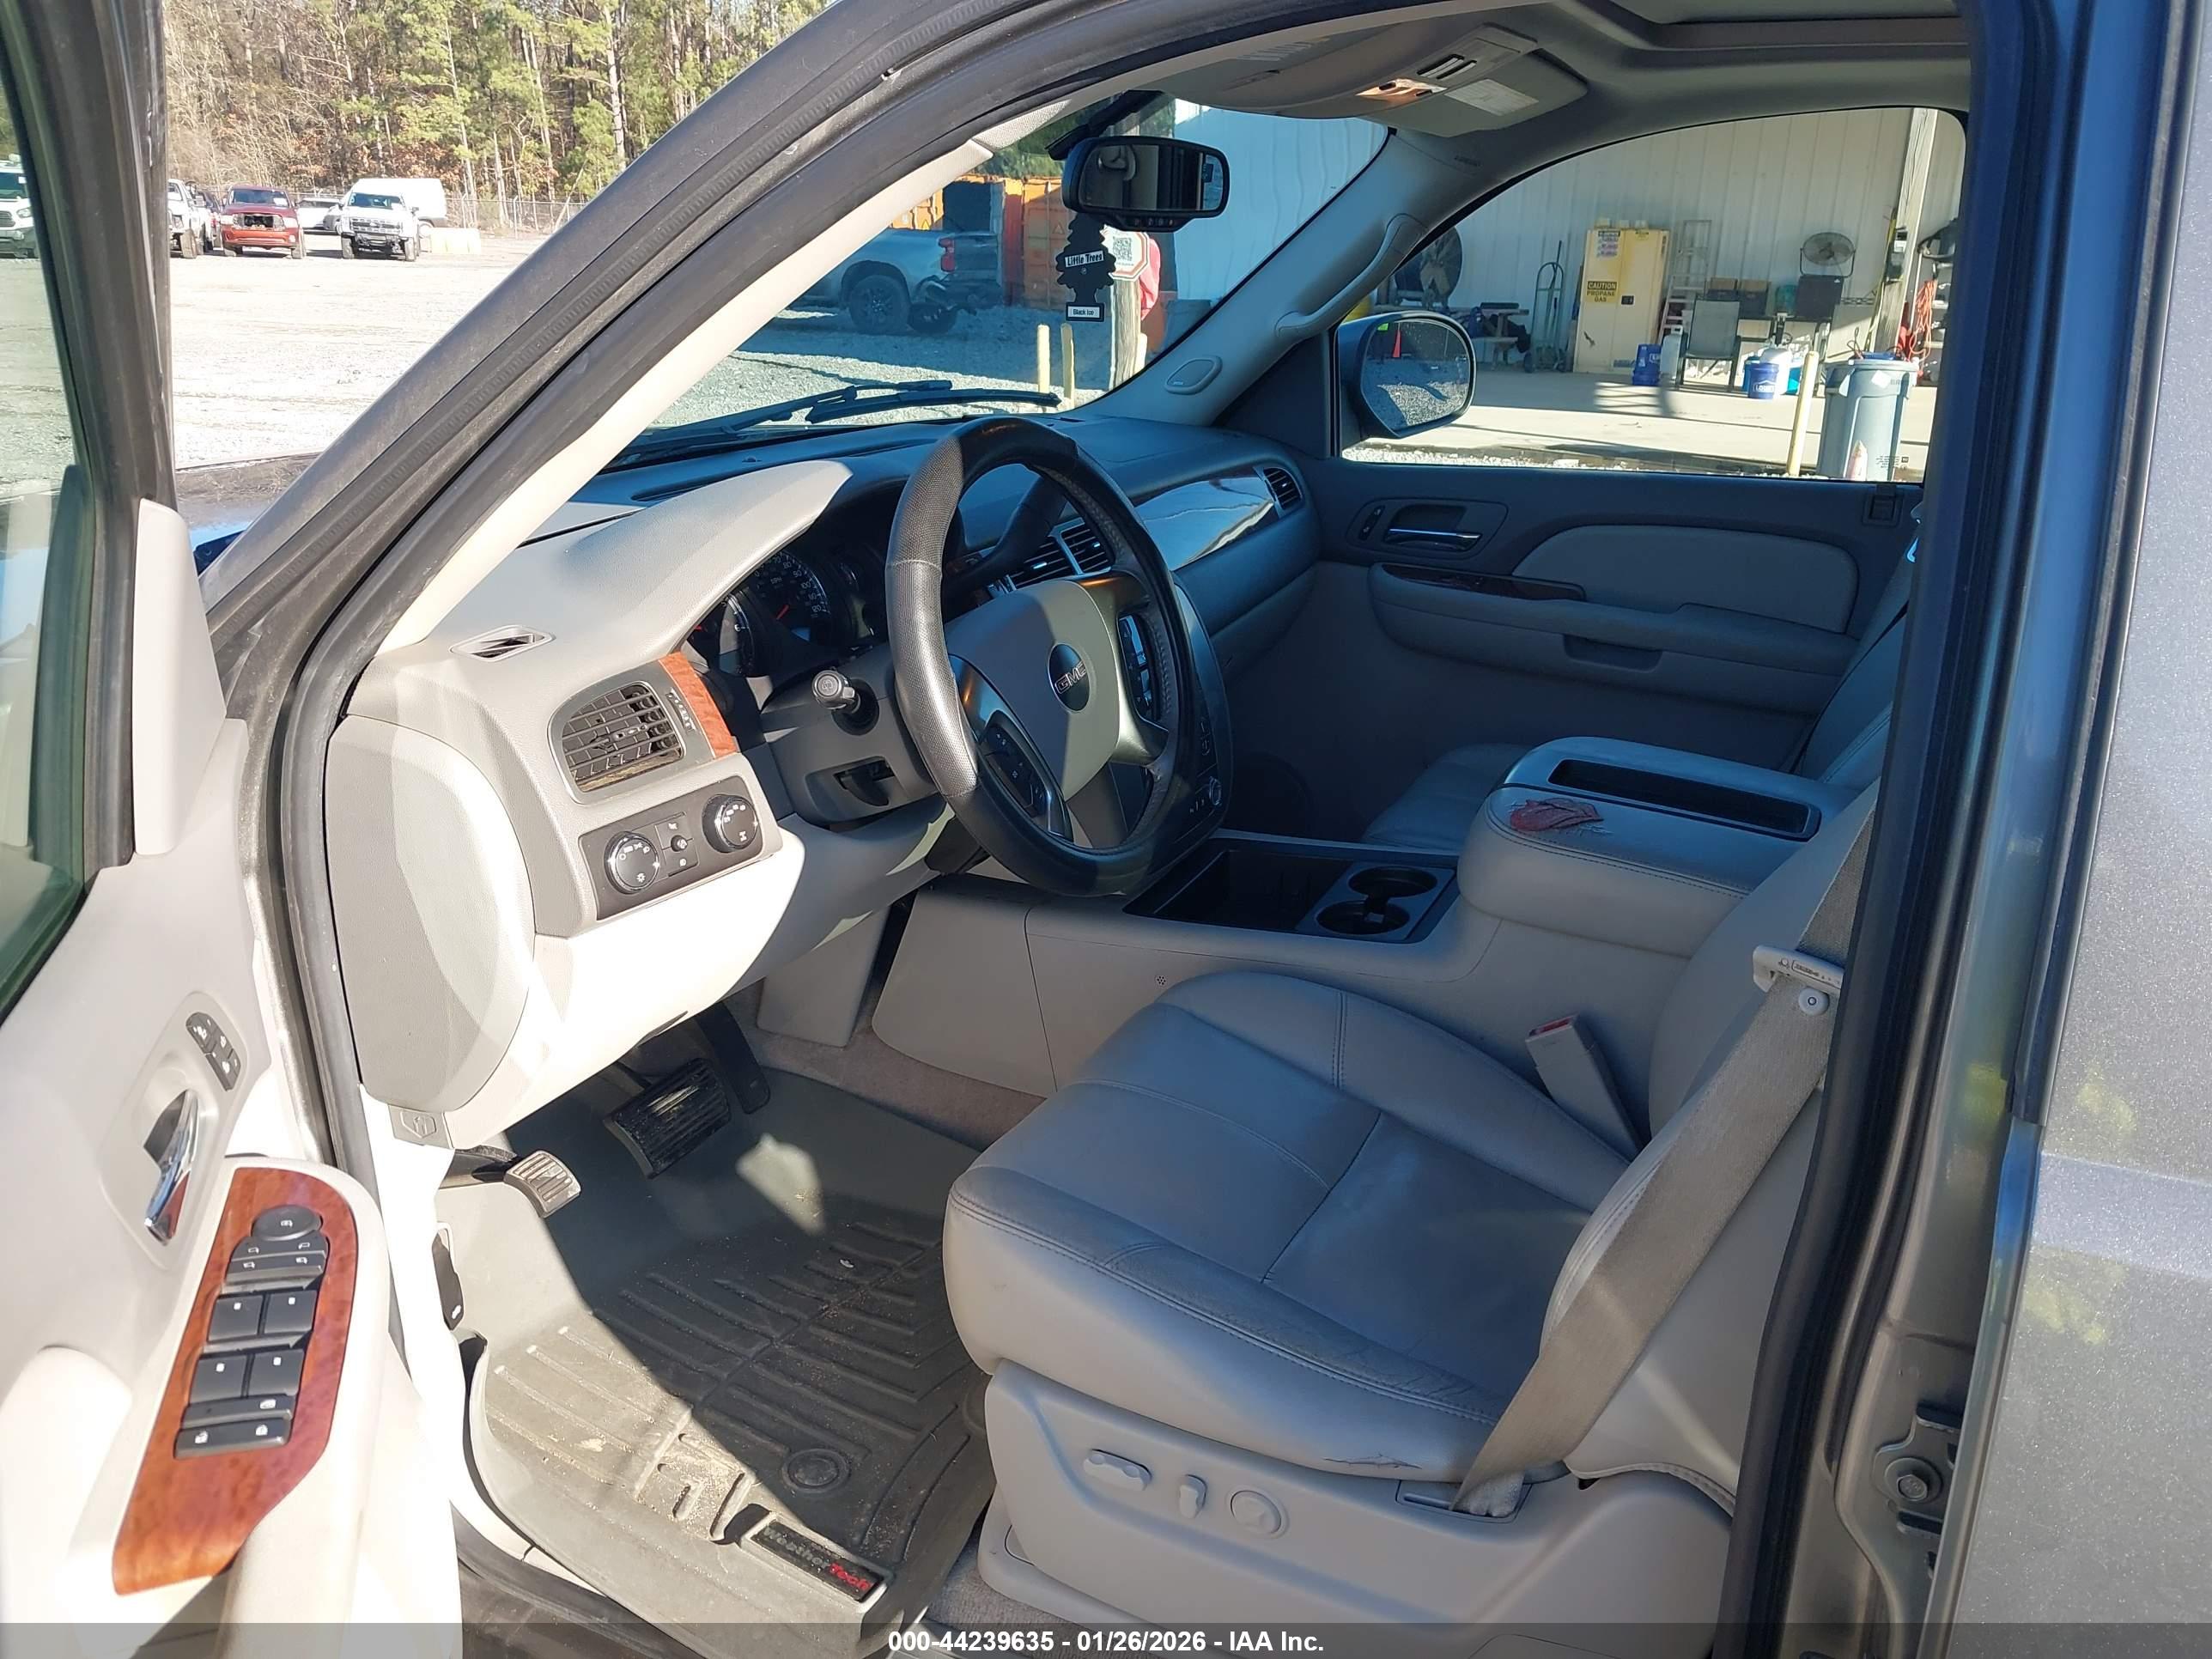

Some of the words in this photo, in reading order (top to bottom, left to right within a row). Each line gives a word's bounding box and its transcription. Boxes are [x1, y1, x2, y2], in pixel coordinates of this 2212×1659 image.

[1067, 254, 1085, 266] Little
[1086, 252, 1103, 263] Trees
[734, 623, 741, 632] 6
[1054, 660, 1086, 694] GMC
[763, 1527, 871, 1590] WeatherTech
